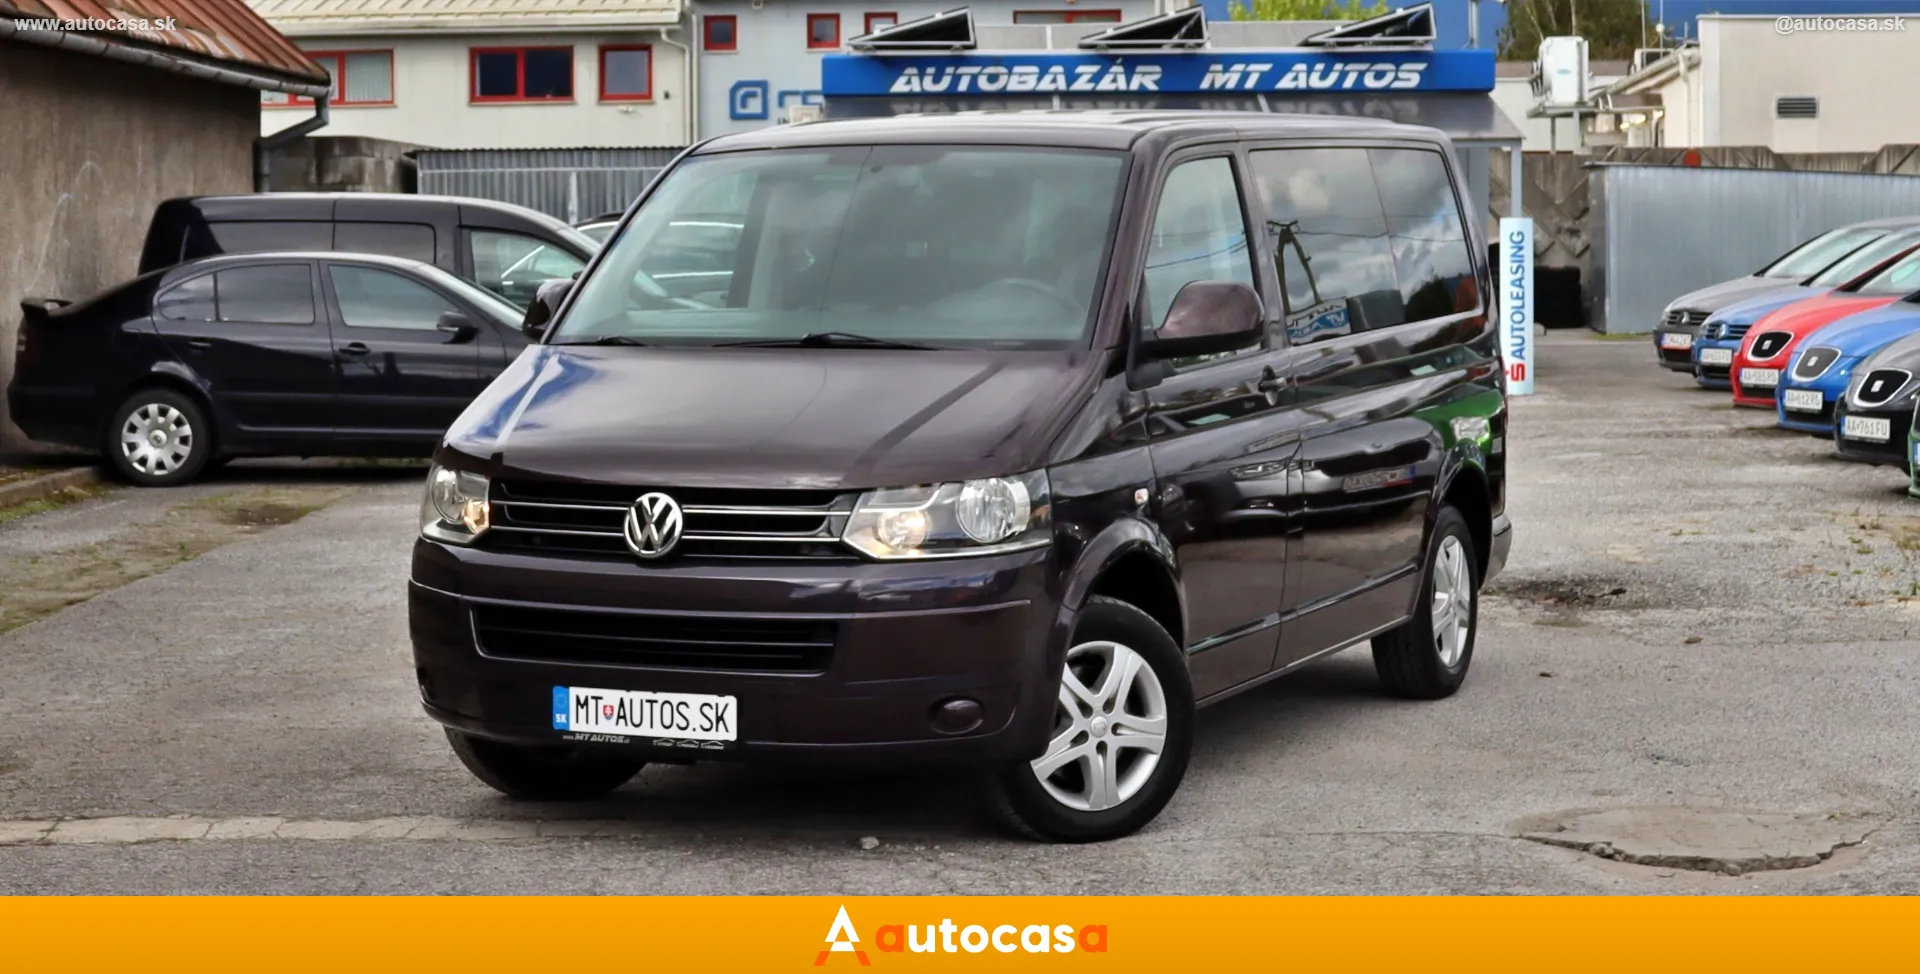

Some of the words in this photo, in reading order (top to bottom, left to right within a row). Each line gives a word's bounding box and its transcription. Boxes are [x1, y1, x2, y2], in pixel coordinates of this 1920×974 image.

[889, 58, 1163, 93] AUTOBAZÁR
[1199, 62, 1274, 90] MT
[1275, 62, 1428, 90] AUTOS
[1510, 230, 1526, 360] AUTOLEASING
[555, 713, 567, 723] SK
[575, 694, 603, 725] MT
[615, 696, 730, 733] AUTOS.SK
